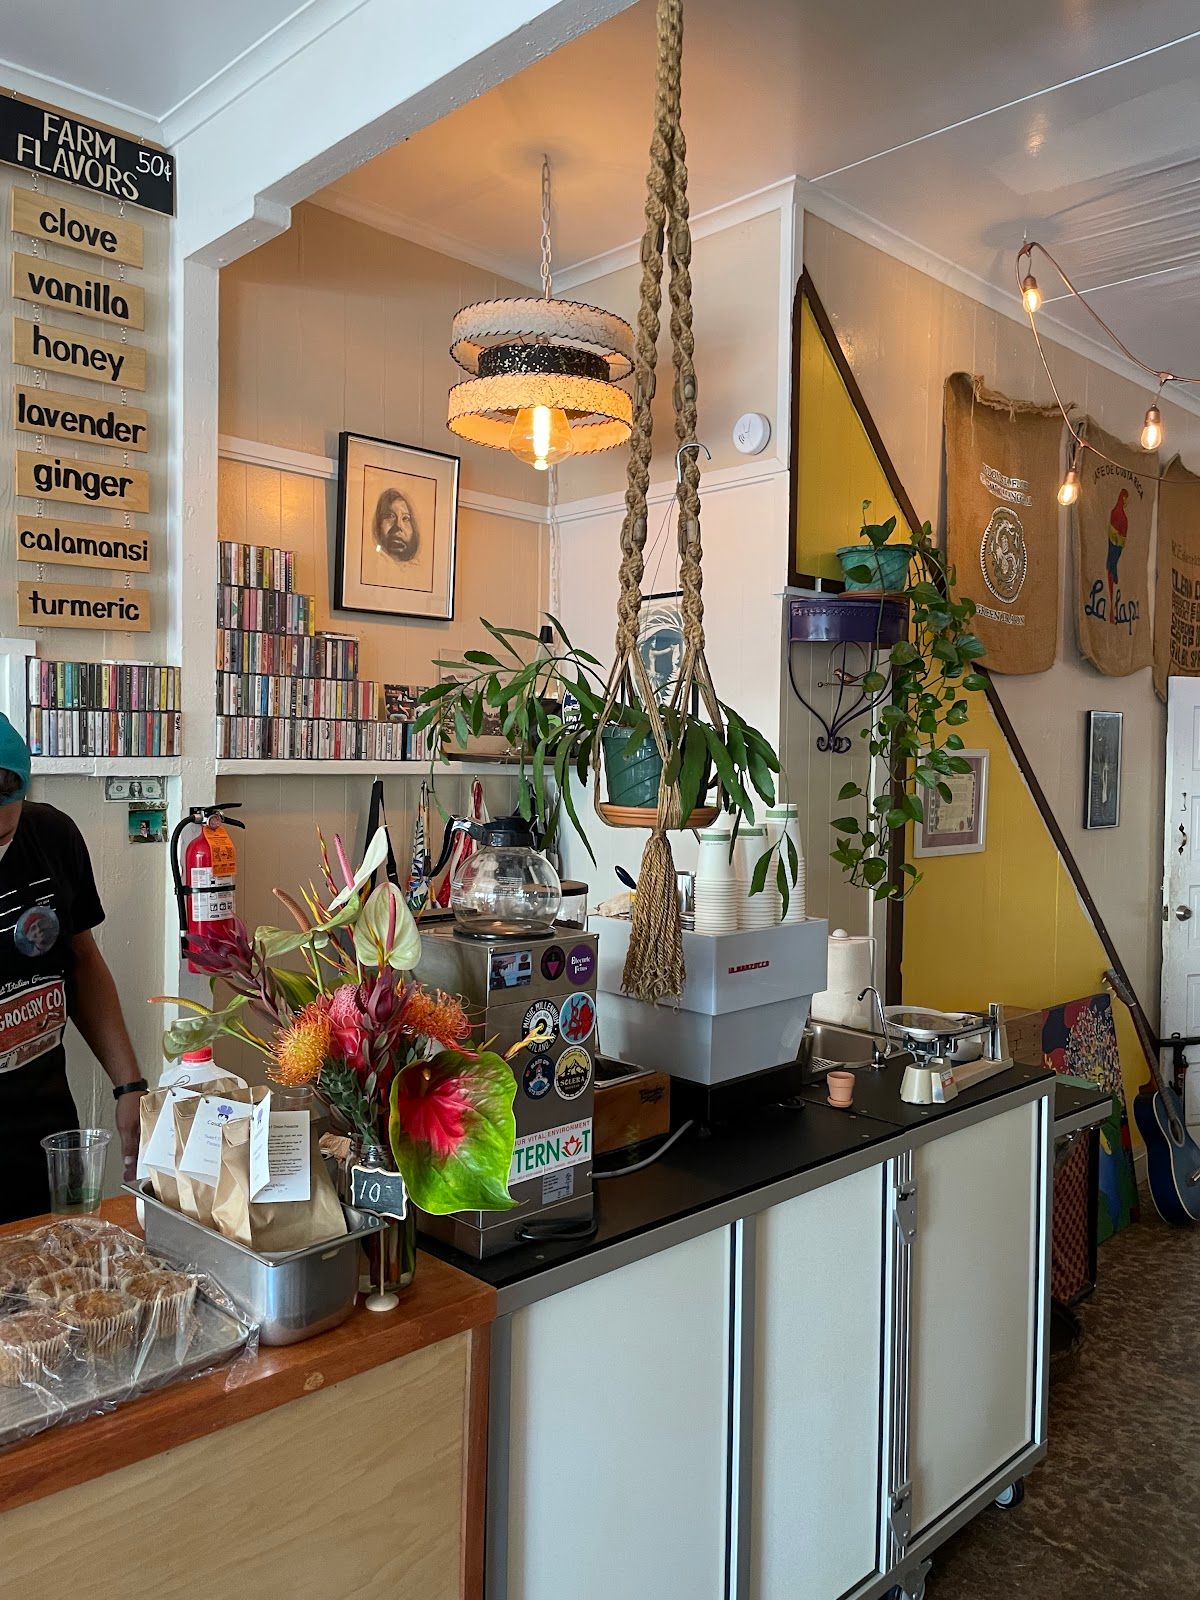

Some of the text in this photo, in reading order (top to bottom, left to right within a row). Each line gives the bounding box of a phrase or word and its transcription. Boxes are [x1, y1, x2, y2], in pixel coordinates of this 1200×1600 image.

[43, 112, 116, 163] FARM
[17, 132, 140, 200] FLAVORS
[135, 151, 172, 182] 50¢
[39, 207, 118, 253] clove
[27, 272, 129, 320] vanilla
[32, 325, 125, 381] honey
[18, 393, 146, 444] lavender
[33, 459, 133, 500] ginger
[20, 527, 148, 562] calamansi
[28, 590, 140, 621] turmeric
[1085, 580, 1106, 622] La
[0, 995, 43, 1031] GROCERY
[522, 1006, 536, 1029] MUSIC
[547, 1120, 590, 1137] ENVIRONMENT
